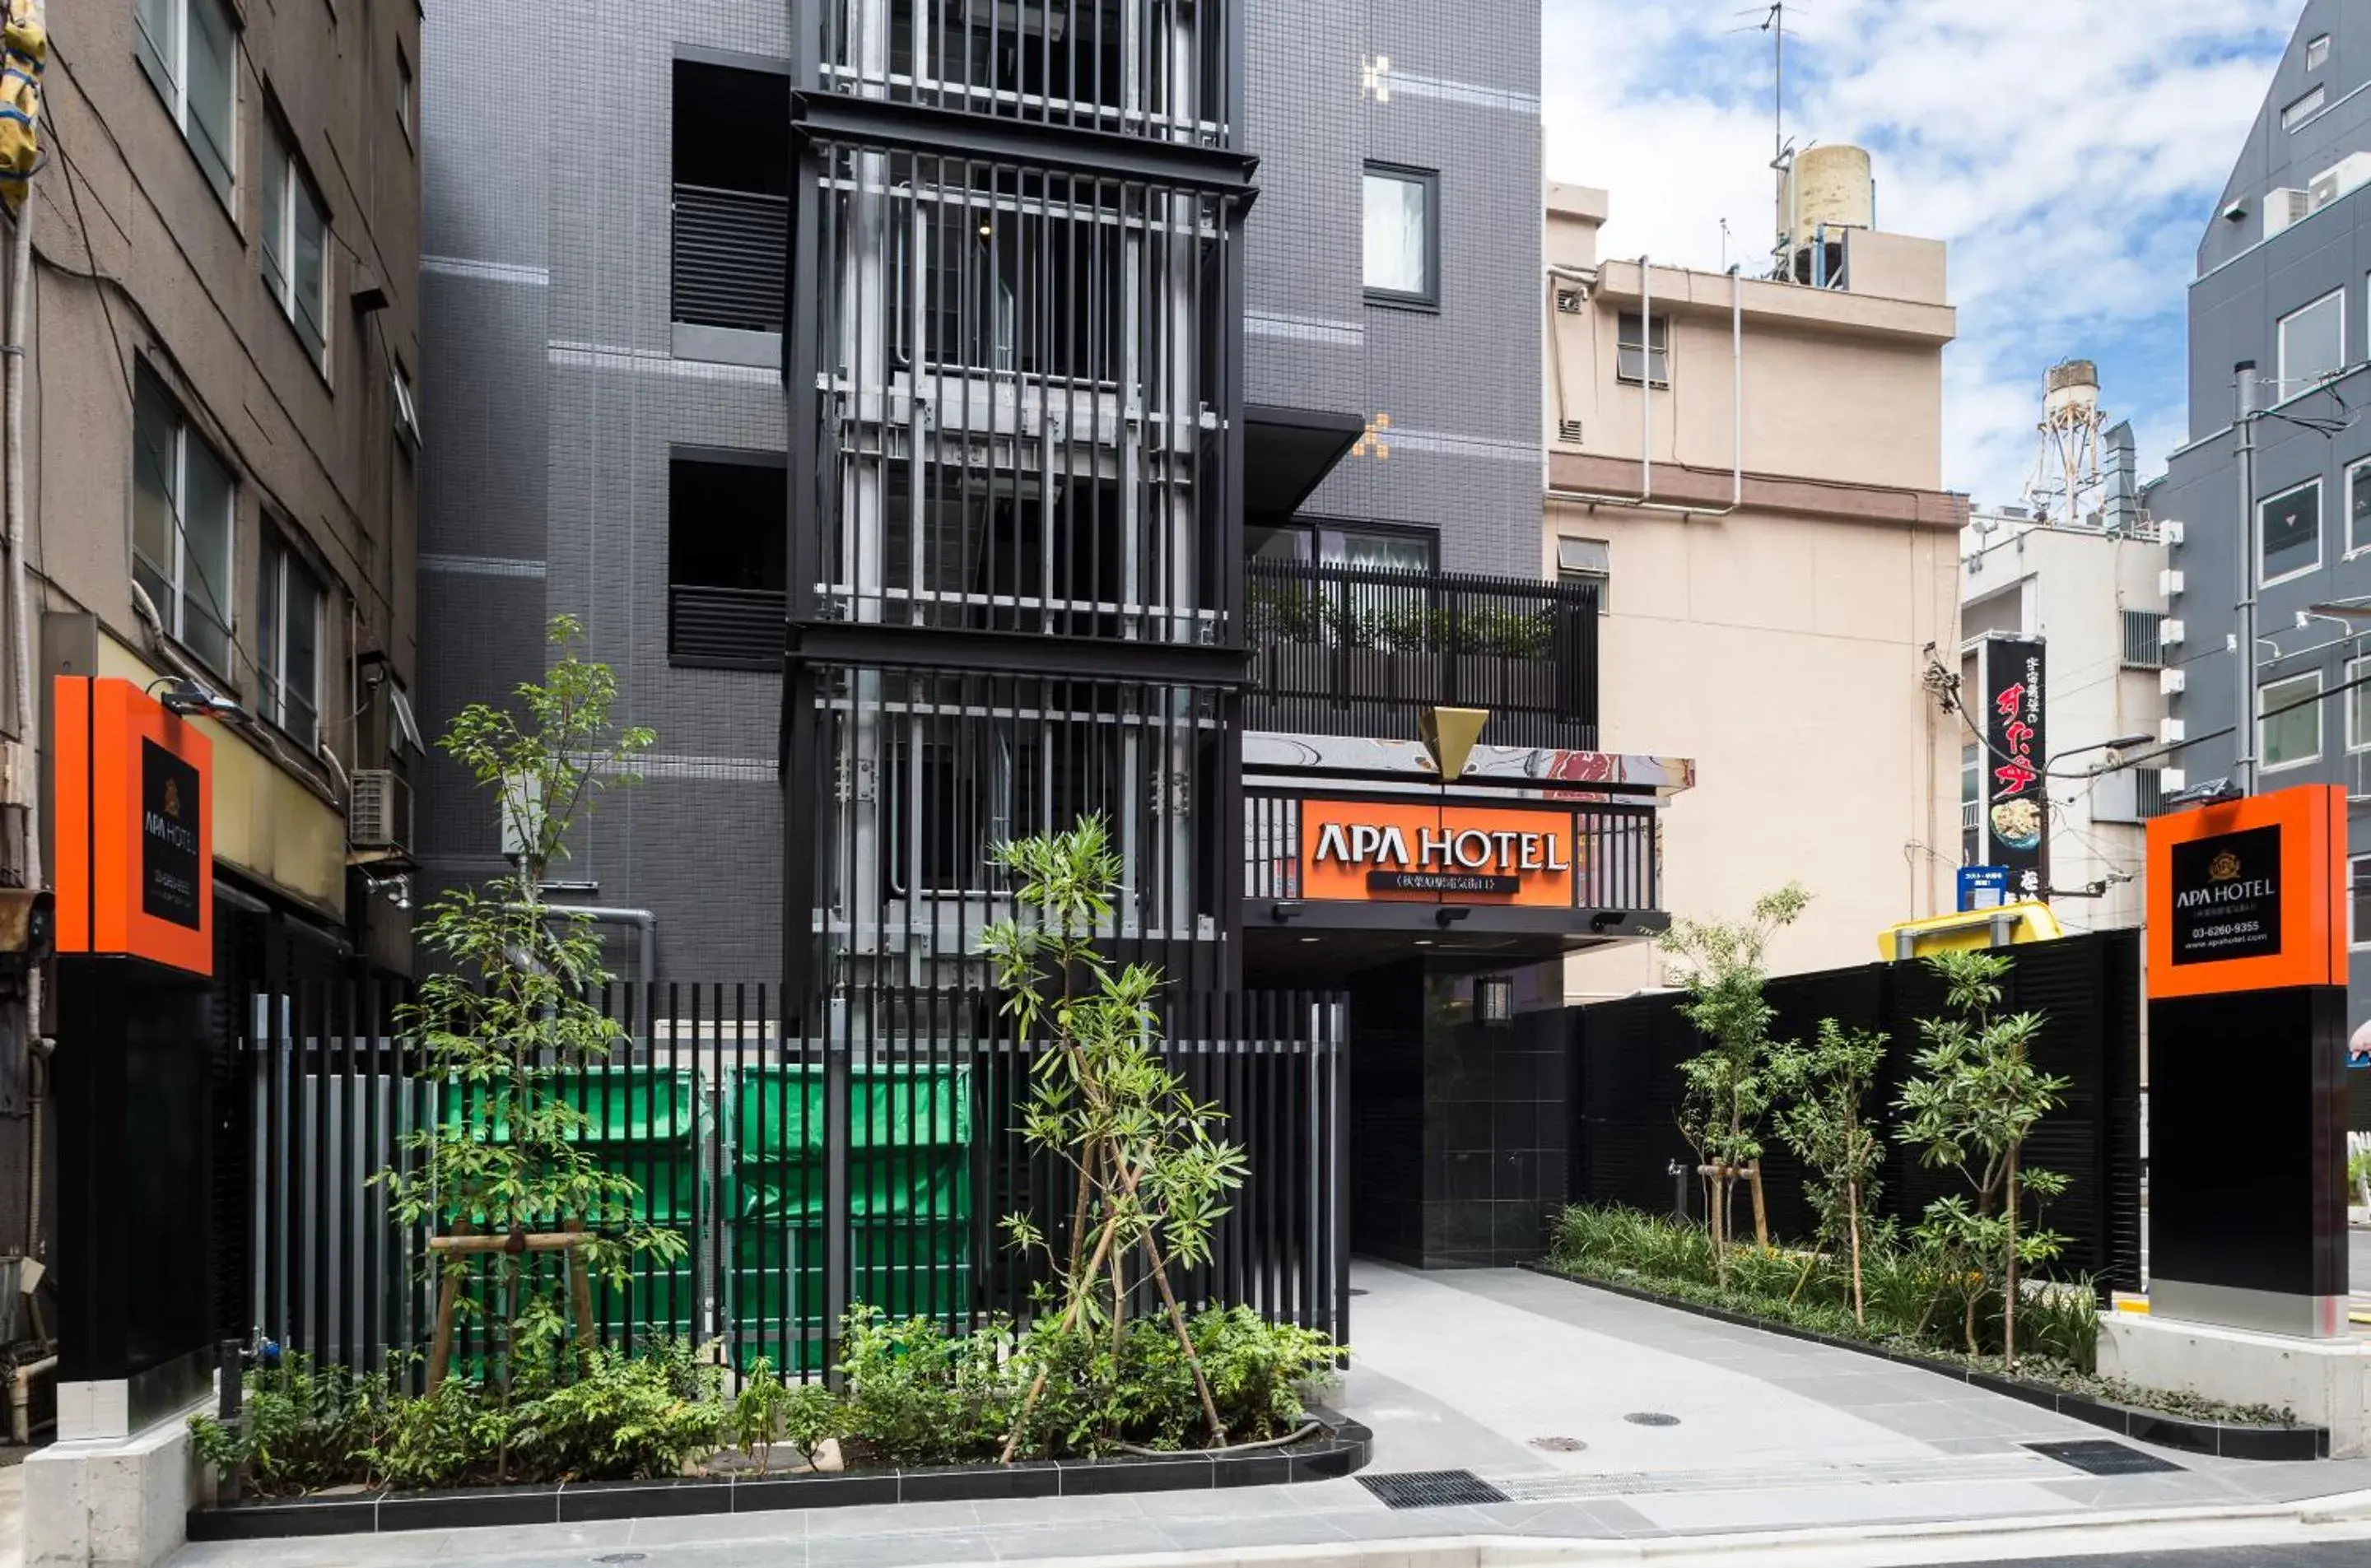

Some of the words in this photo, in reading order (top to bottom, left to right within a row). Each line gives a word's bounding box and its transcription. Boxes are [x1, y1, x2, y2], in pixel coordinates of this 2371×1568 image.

[145, 811, 165, 840] APA
[167, 822, 198, 855] HOTEL
[1315, 823, 1410, 865] APA
[1418, 827, 1570, 871] HOTEL
[2177, 888, 2211, 909] APA
[2214, 878, 2276, 902] HOTEL
[2192, 920, 2260, 938] 03-6260-9355
